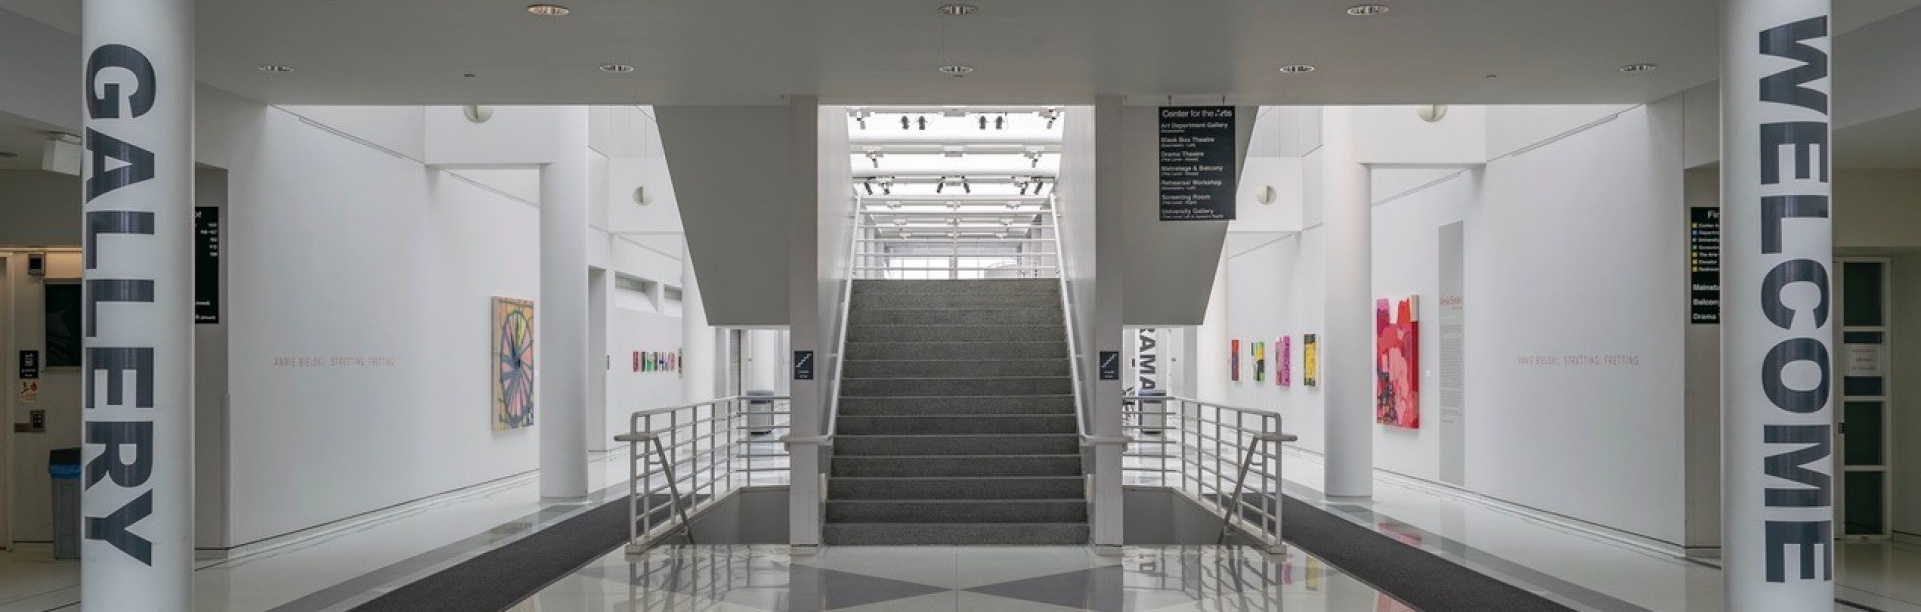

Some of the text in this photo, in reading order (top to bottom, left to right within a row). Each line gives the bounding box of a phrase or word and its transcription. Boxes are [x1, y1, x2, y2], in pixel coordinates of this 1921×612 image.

[84, 43, 157, 567] GALLERY
[1162, 109, 1189, 118] Center
[1190, 109, 1200, 117] for
[1201, 109, 1214, 117] the
[1758, 15, 1832, 583] WELCOME
